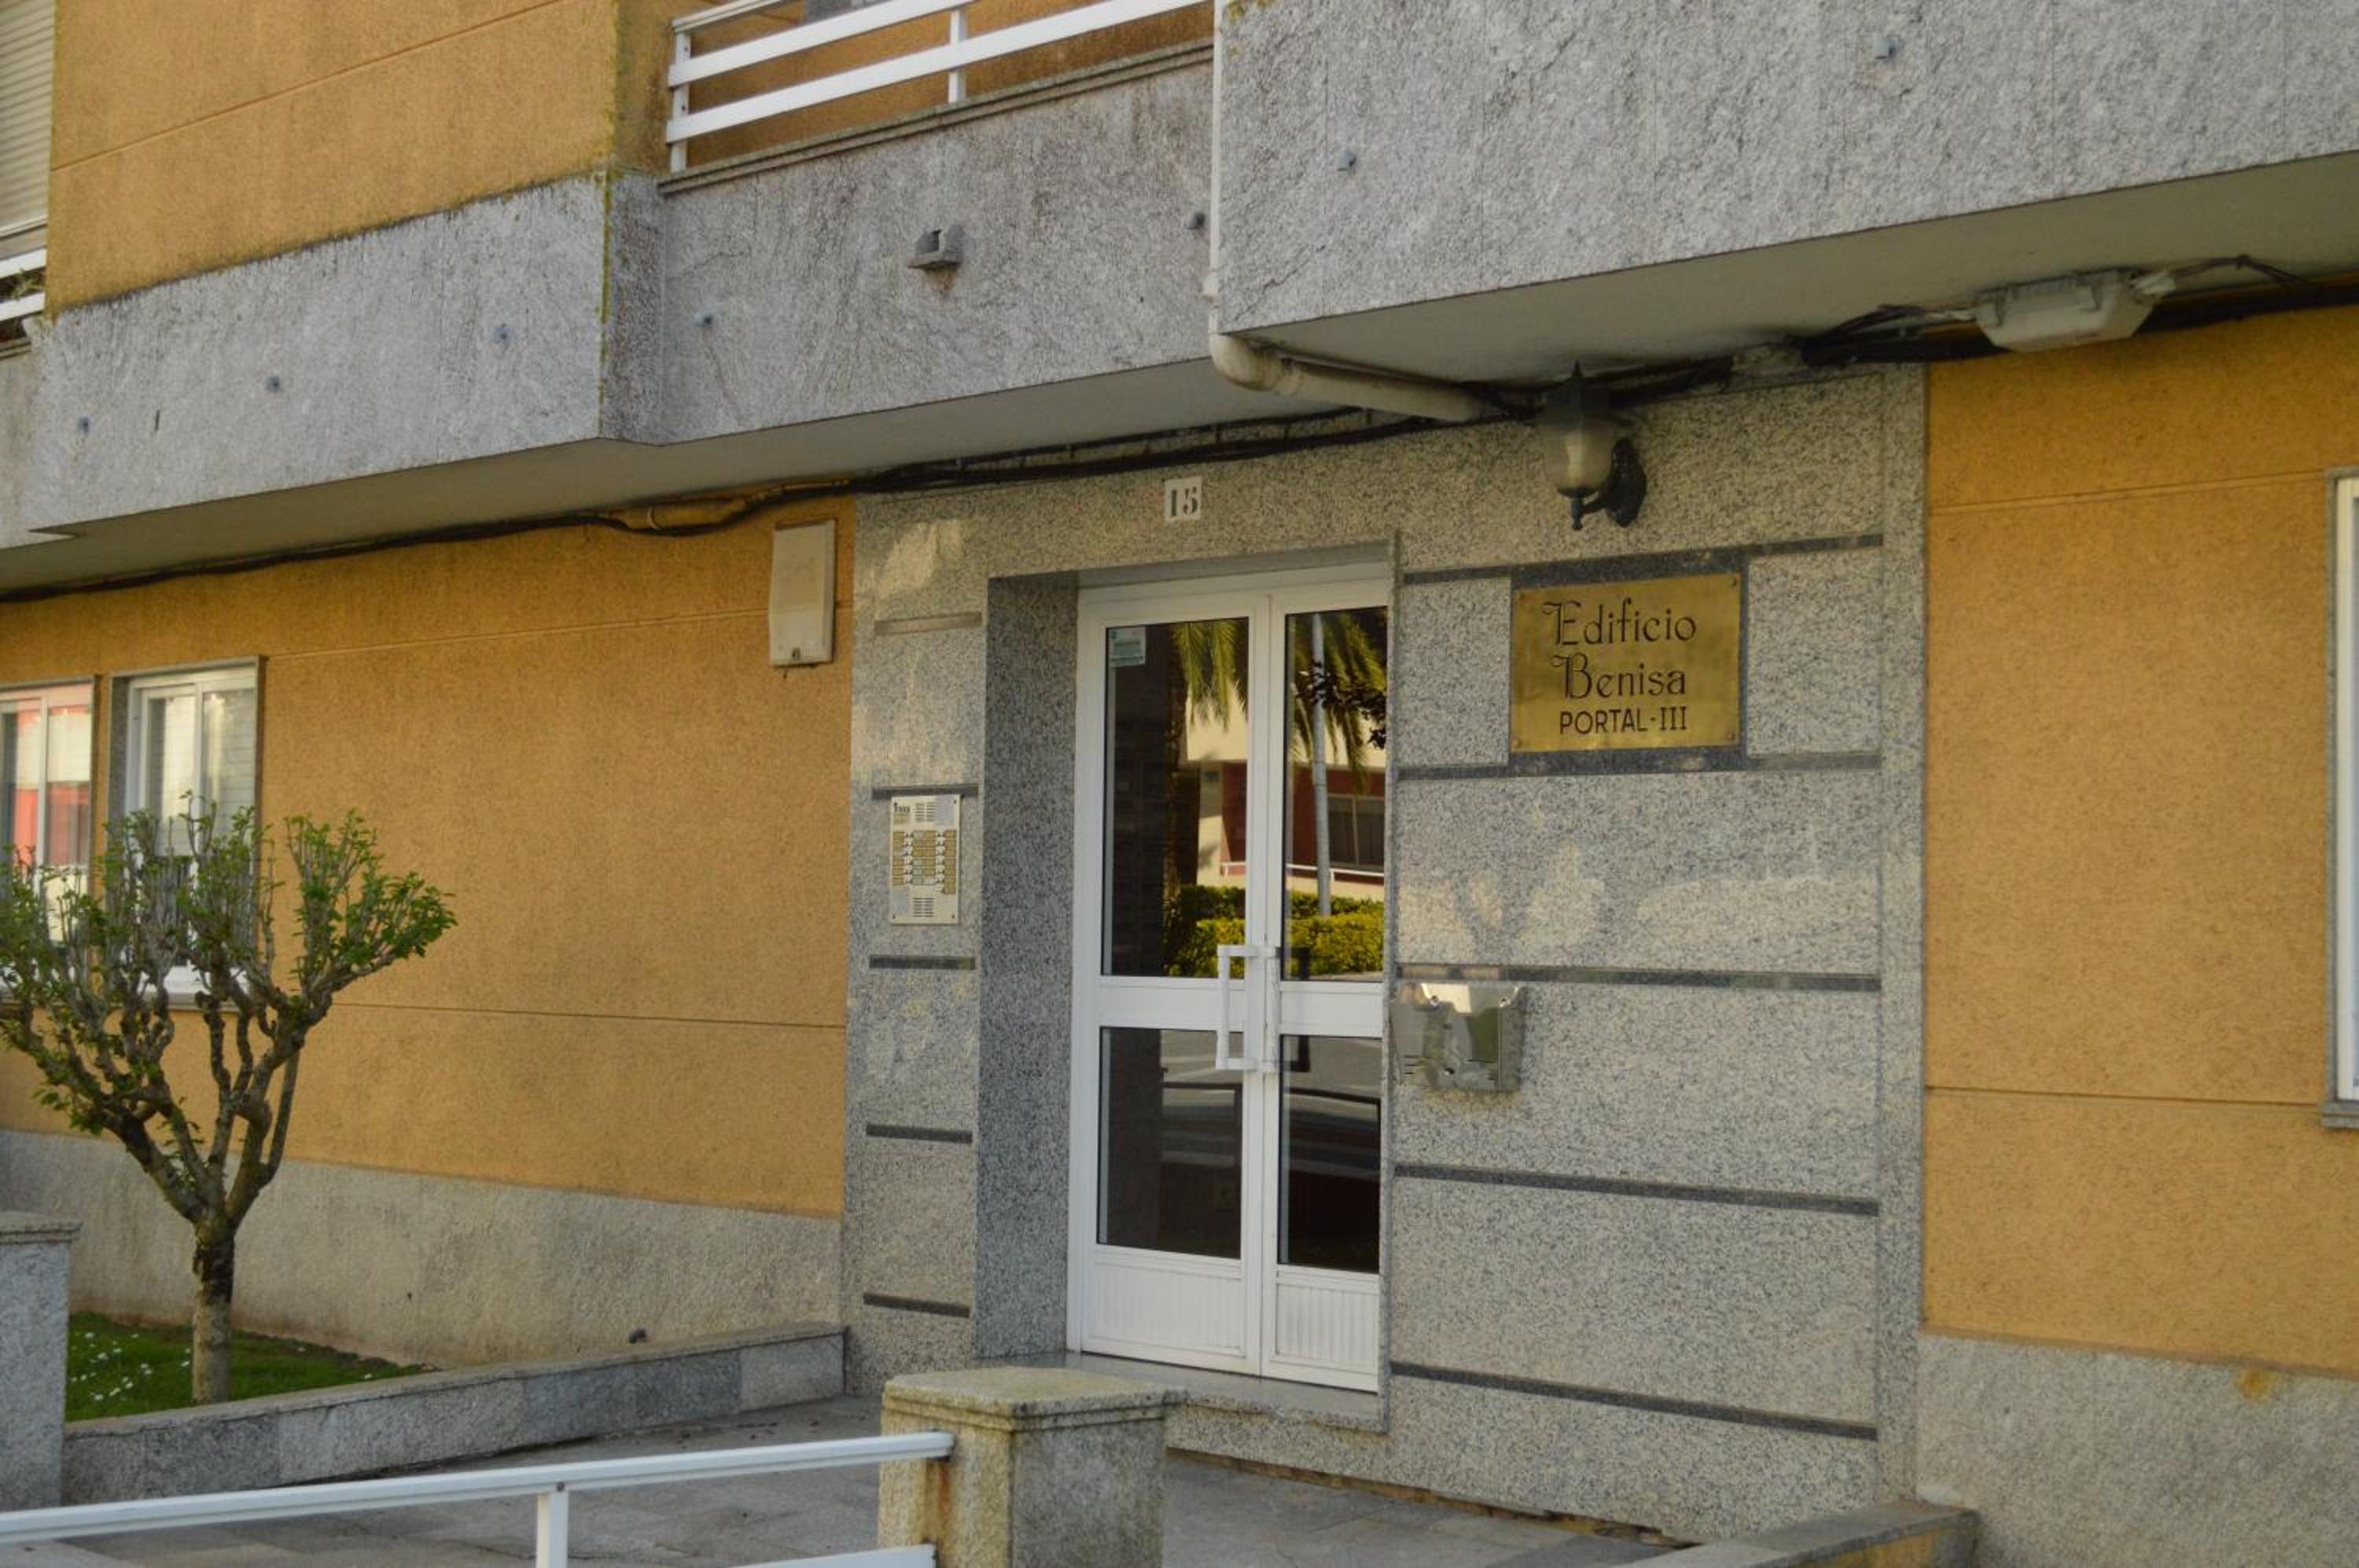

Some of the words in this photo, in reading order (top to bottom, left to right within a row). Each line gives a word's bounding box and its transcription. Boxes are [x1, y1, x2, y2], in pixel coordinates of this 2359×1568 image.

[1170, 486, 1198, 517] 15
[1541, 597, 1697, 646] Edificio
[1550, 652, 1687, 699] Benisa
